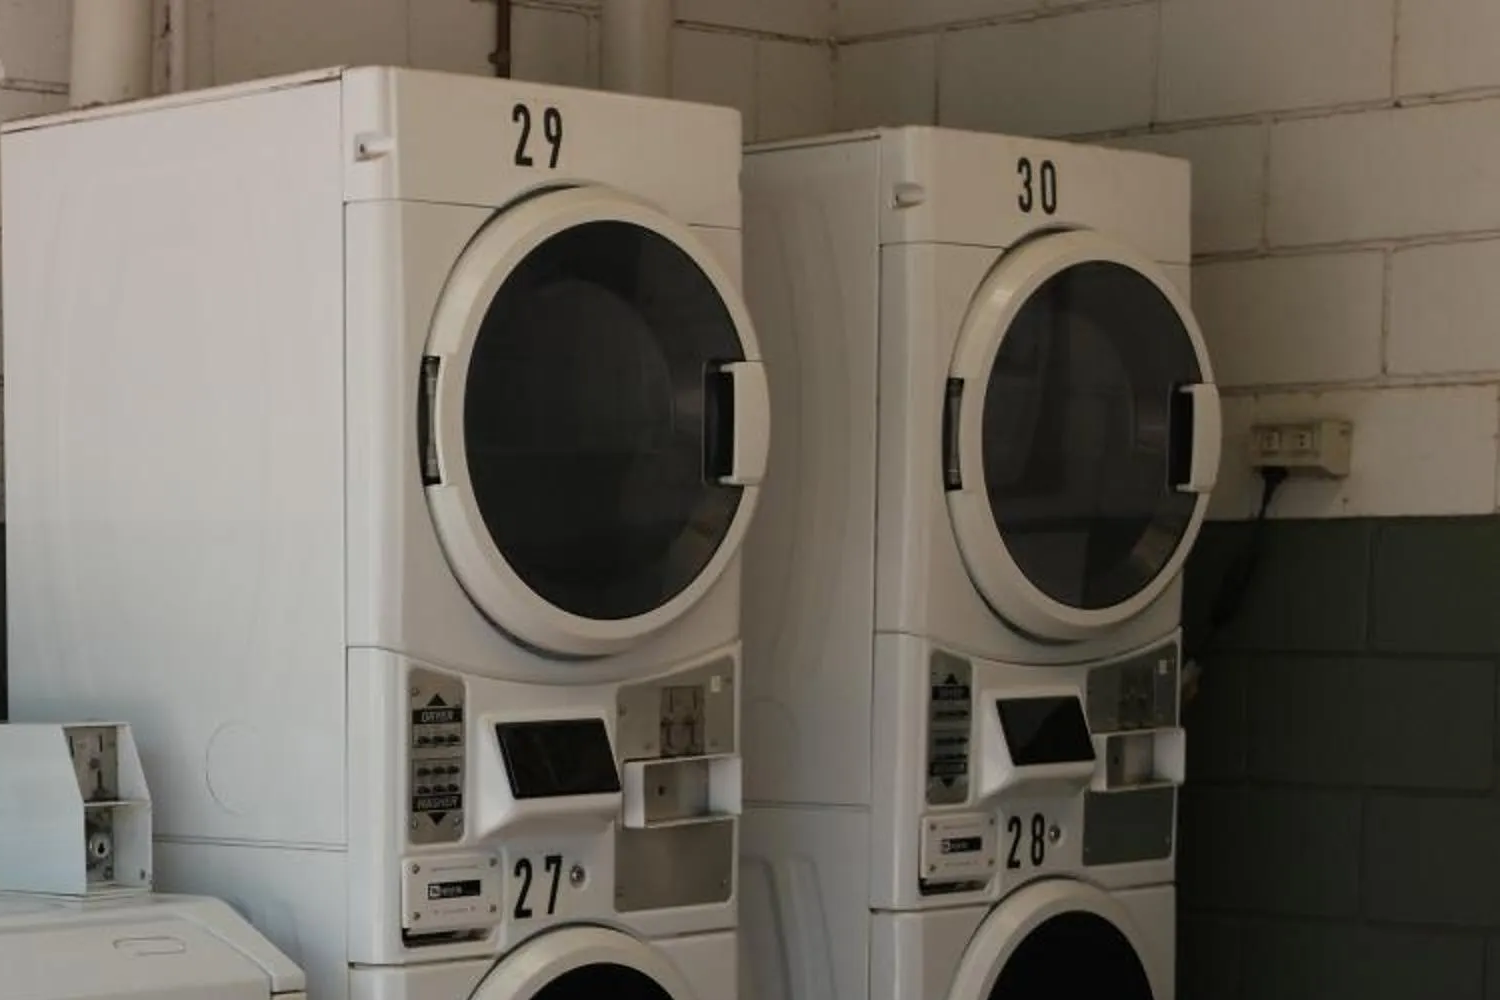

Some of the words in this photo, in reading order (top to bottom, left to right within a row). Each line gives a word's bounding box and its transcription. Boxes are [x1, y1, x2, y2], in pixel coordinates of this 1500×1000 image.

[512, 103, 563, 169] 29
[1017, 157, 1057, 215] 30
[1006, 812, 1046, 870] 28
[514, 854, 563, 919] 27
